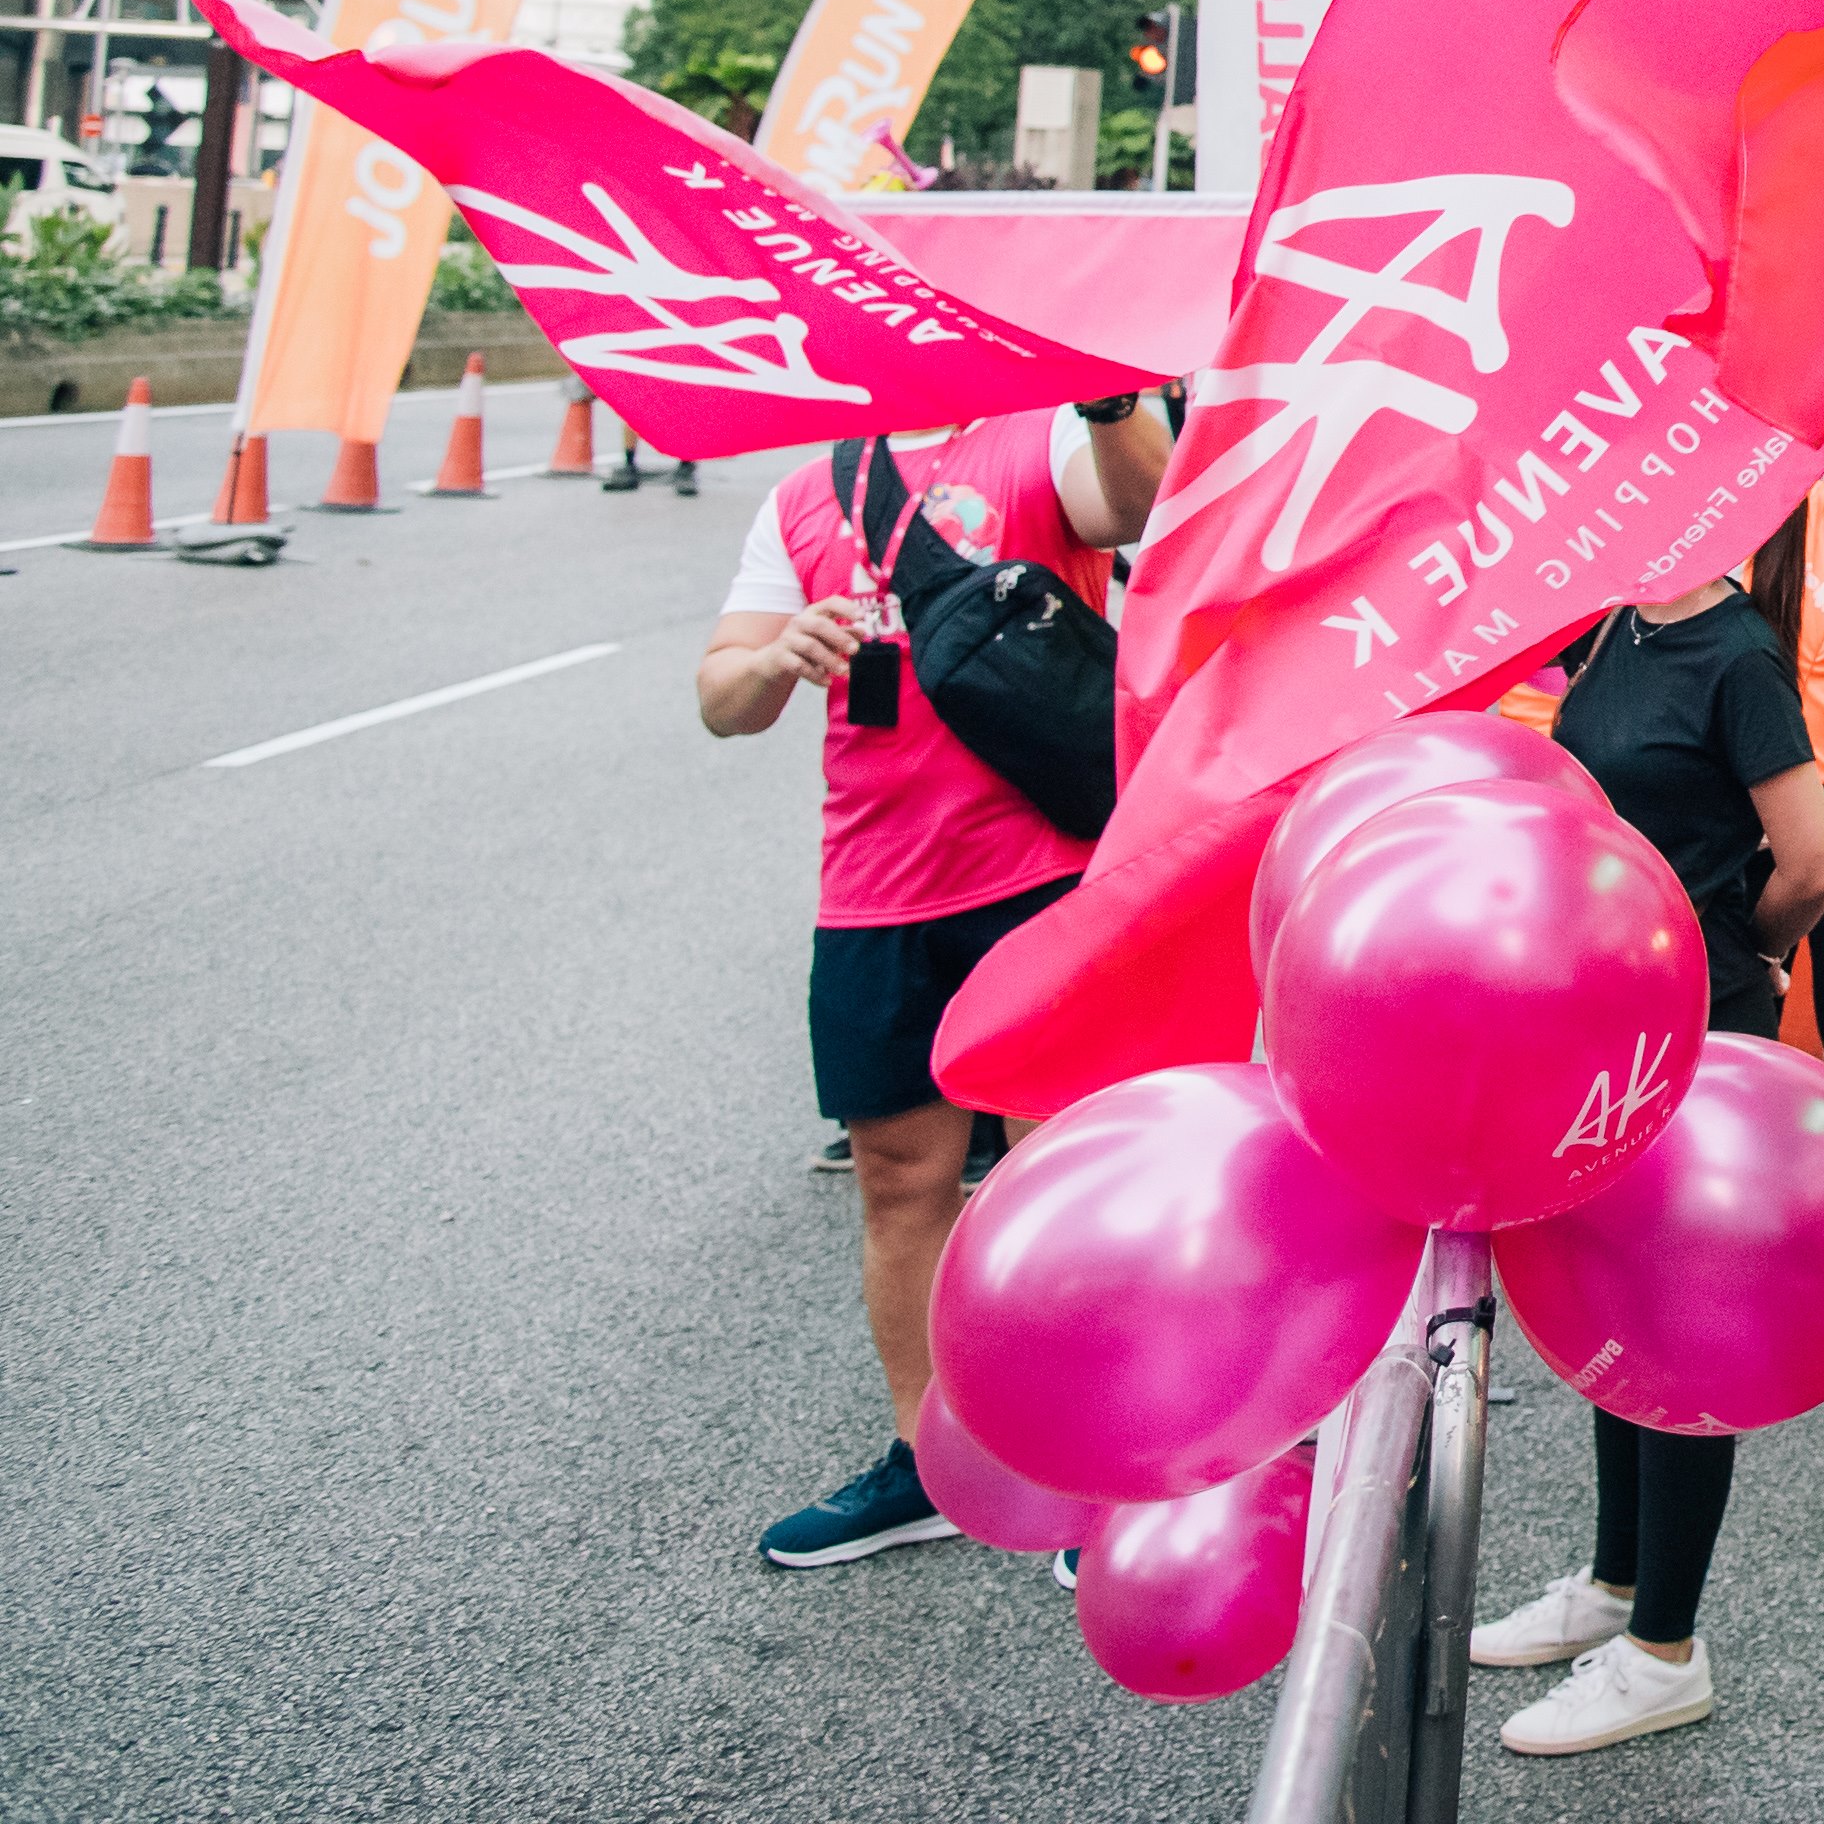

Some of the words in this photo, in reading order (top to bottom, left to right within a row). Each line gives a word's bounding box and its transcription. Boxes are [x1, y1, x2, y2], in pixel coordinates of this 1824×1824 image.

[721, 205, 965, 345] AVENUE
[1551, 1031, 1673, 1159] AK
[1568, 1120, 1655, 1181] AVENUE
